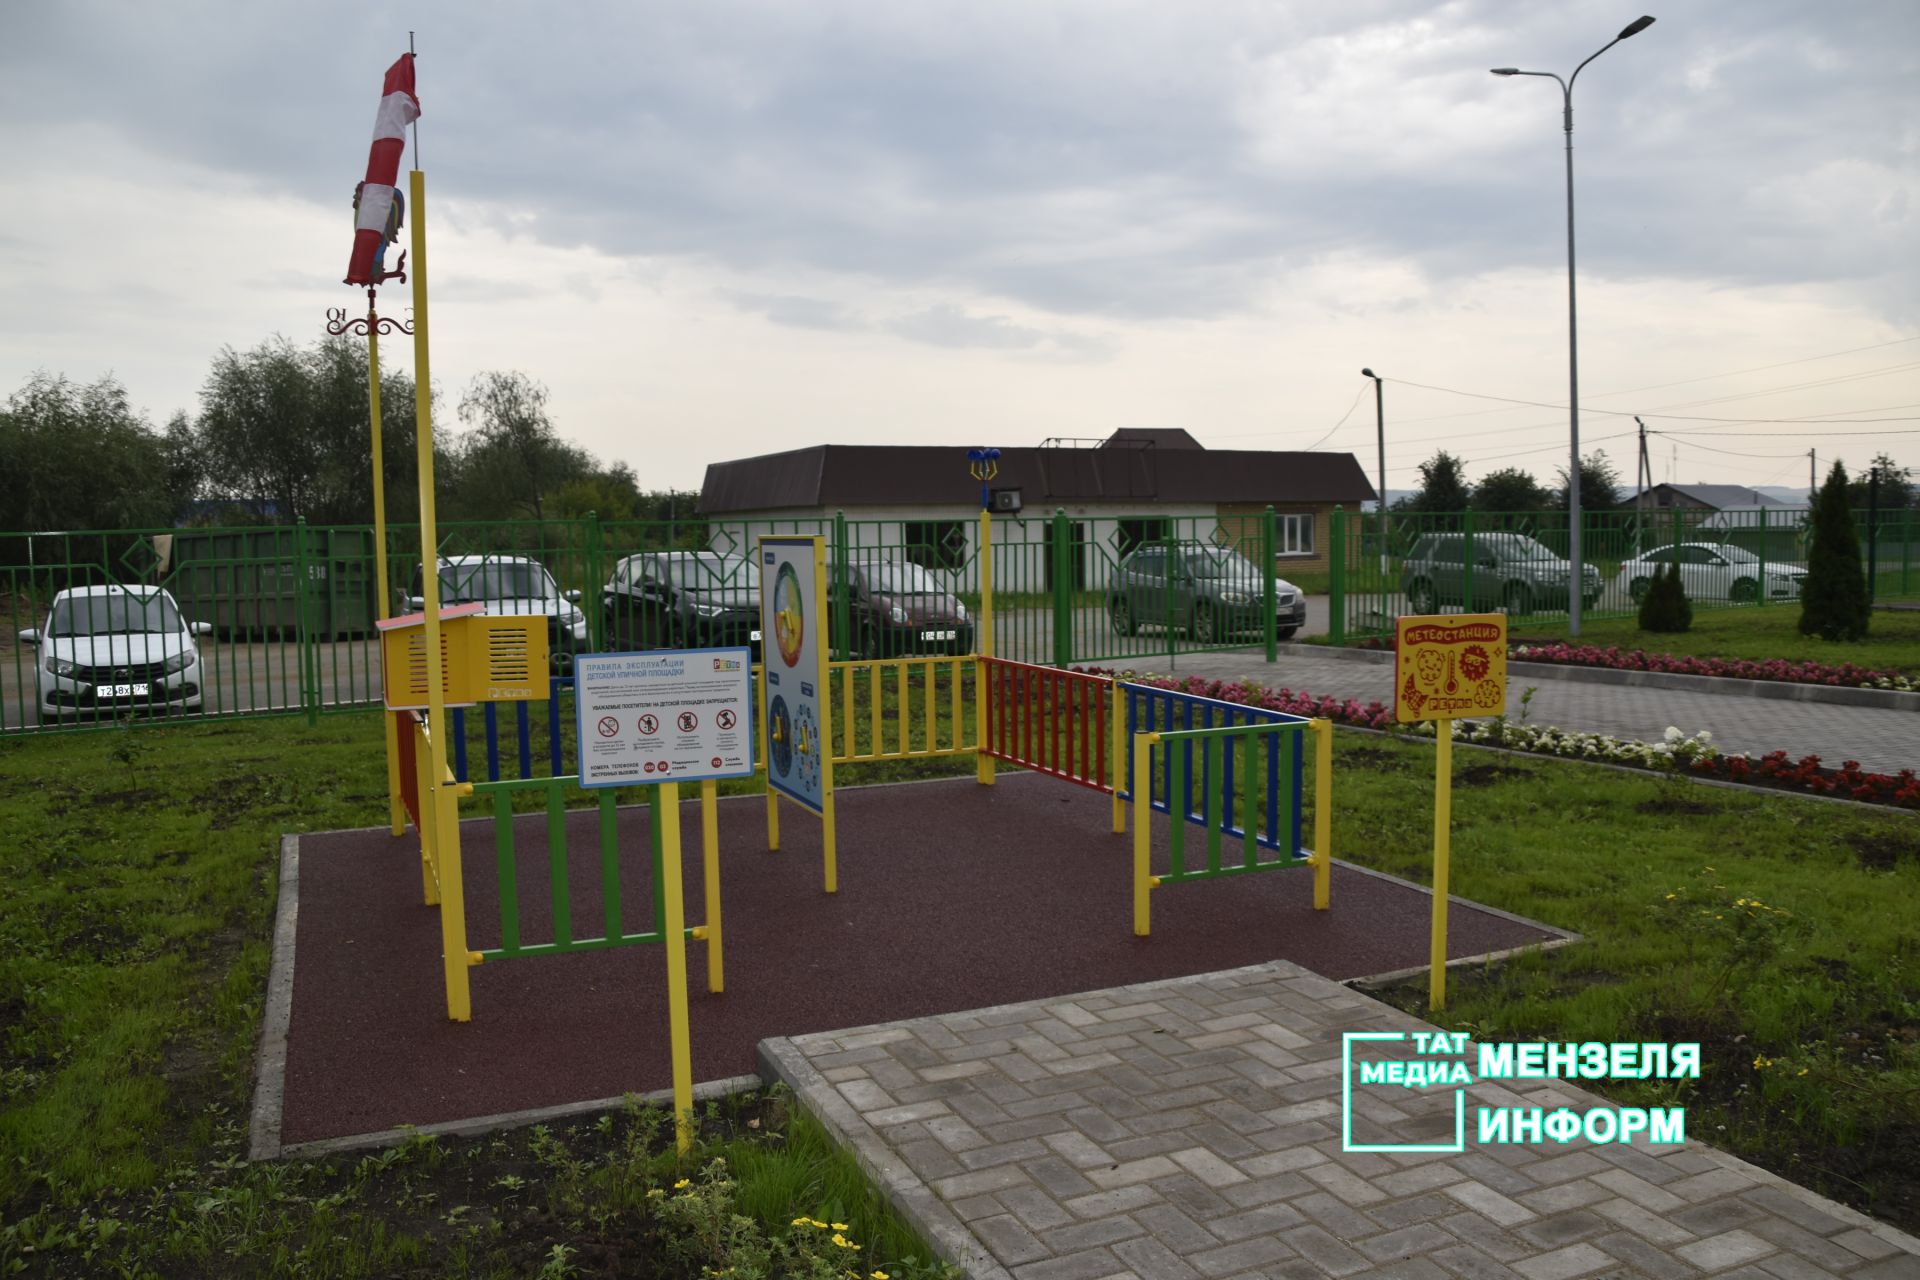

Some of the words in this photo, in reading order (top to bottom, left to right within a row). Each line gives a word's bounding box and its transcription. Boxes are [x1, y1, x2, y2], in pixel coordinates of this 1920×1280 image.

[1407, 627, 1499, 642] МЕТЕОСТАНЦИЯ
[586, 663, 622, 671] ПРАВИЛА
[626, 660, 684, 670] ЭКСПЛУАТАЦИИ
[586, 671, 616, 681] ДЕТСКОЙ
[617, 669, 647, 679] УЛИЧНОЙ
[648, 668, 684, 678] ПЛОЩАДКИ
